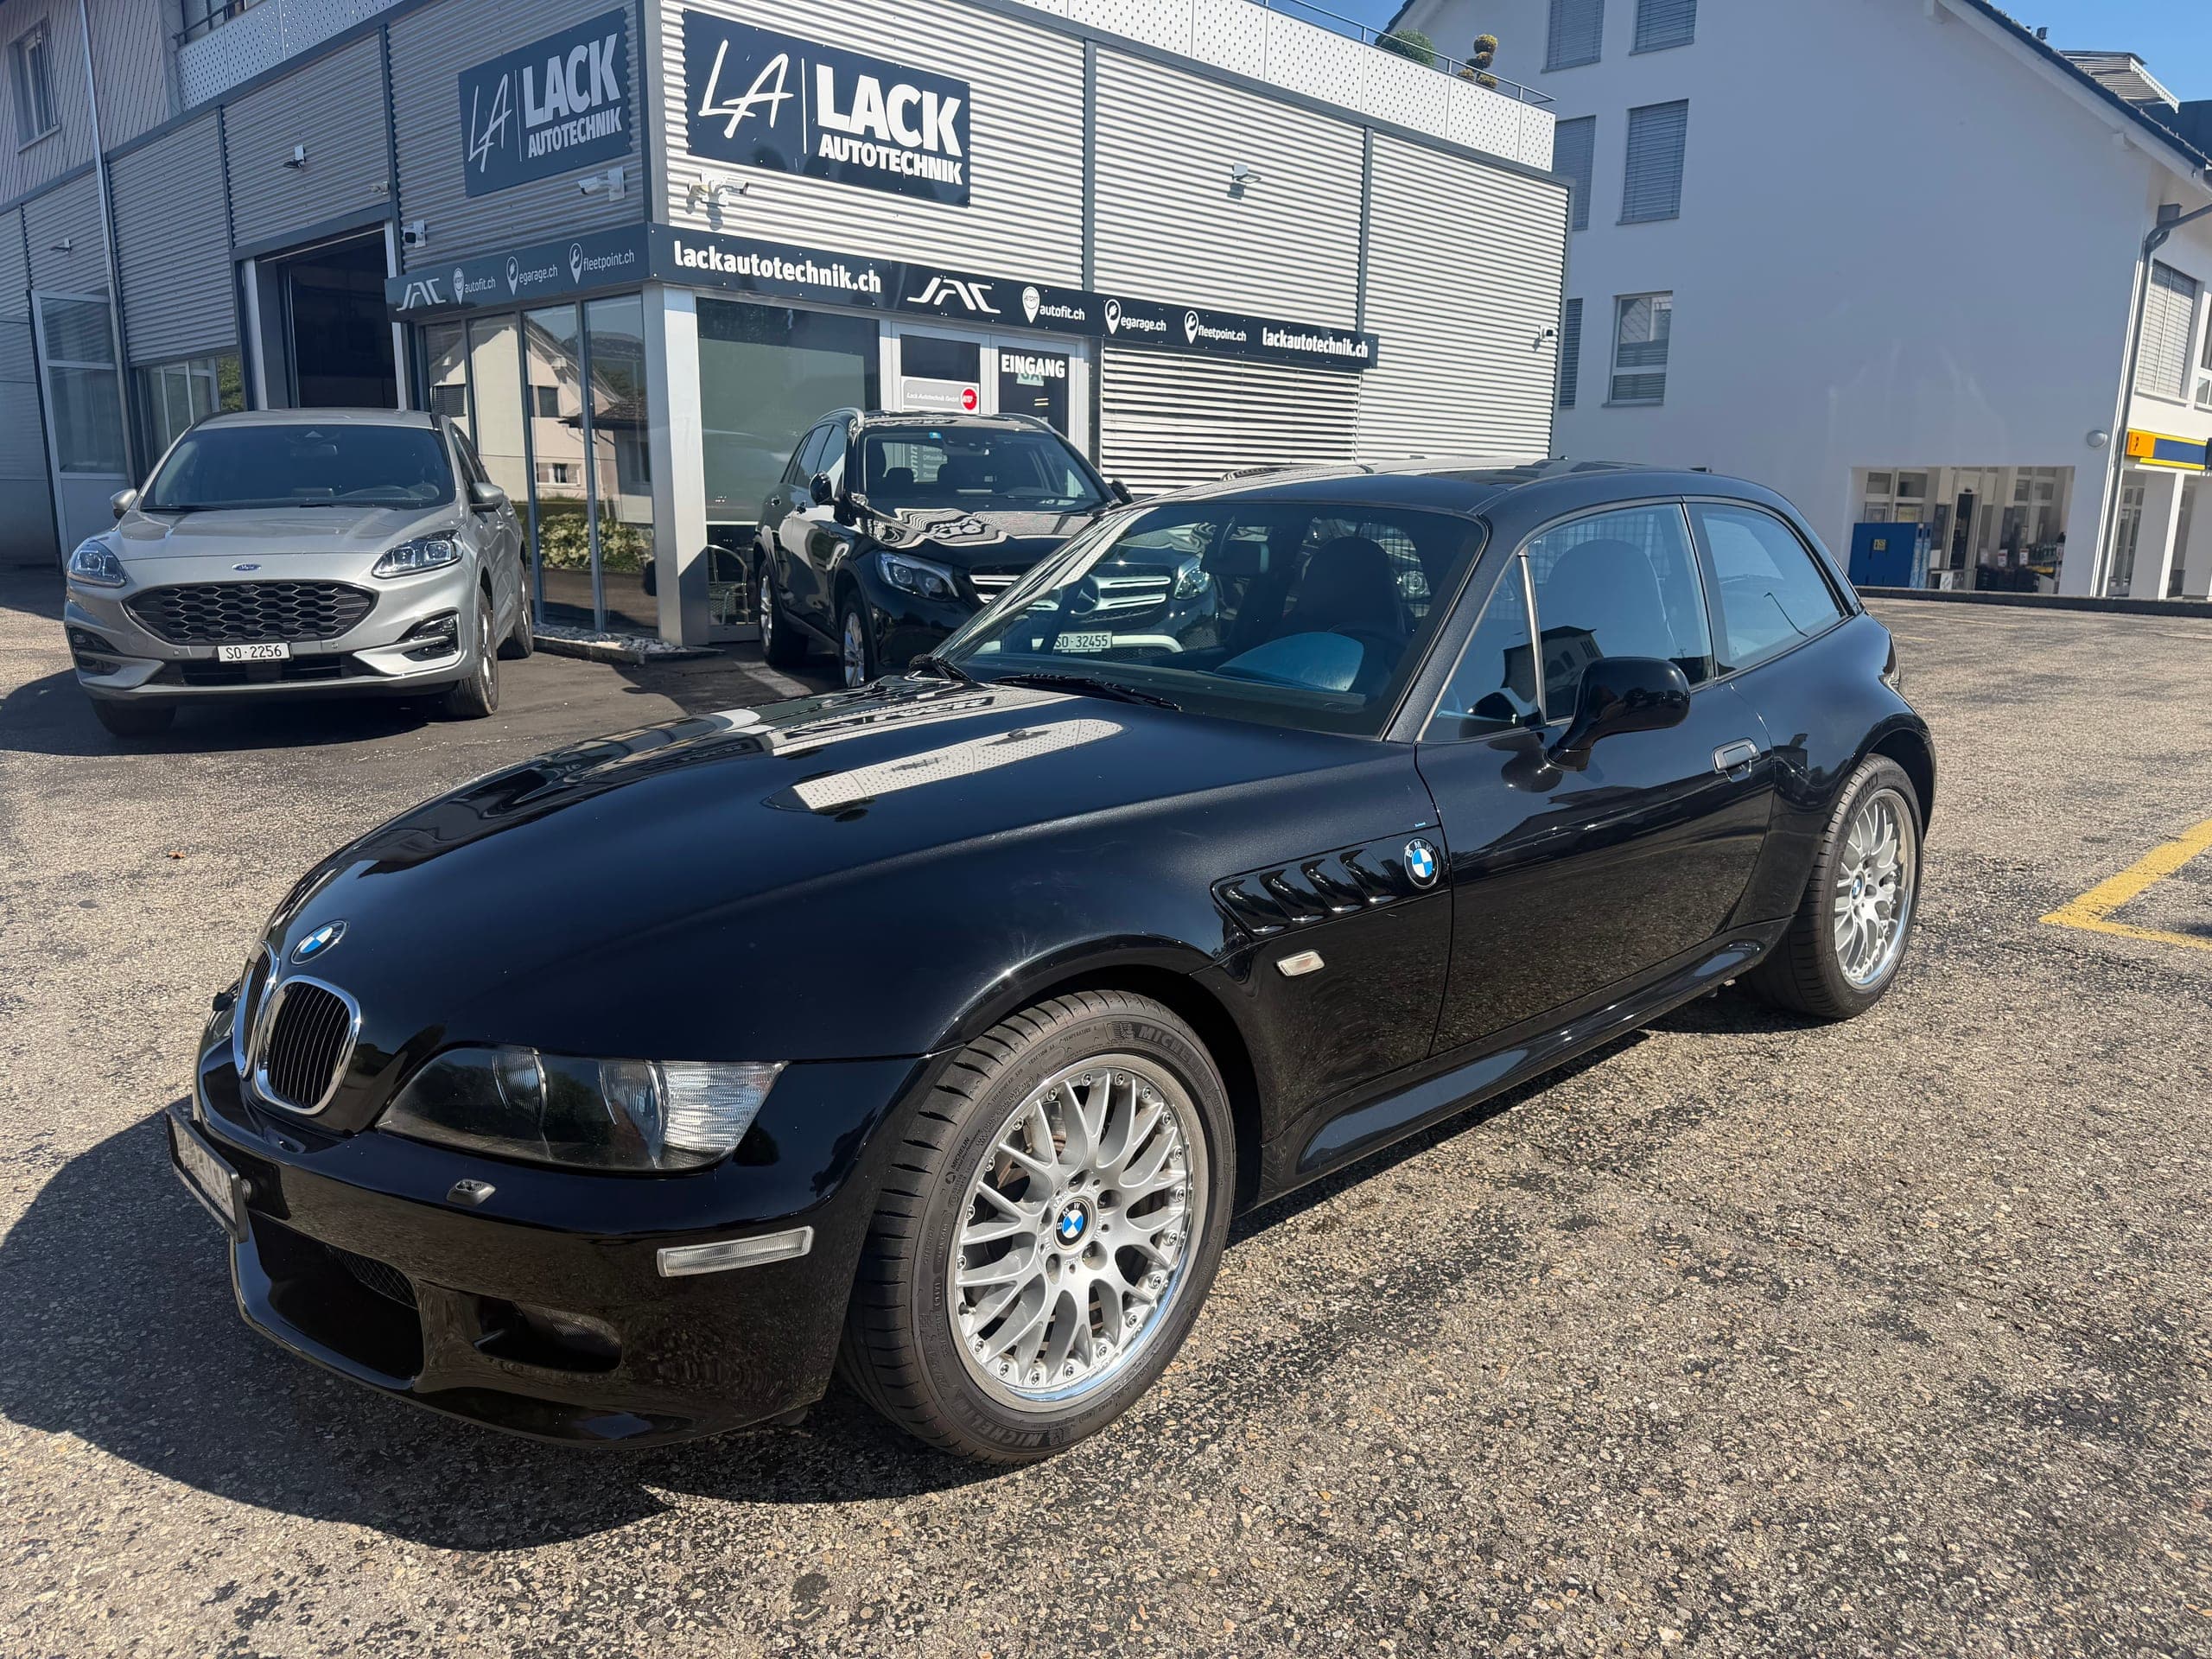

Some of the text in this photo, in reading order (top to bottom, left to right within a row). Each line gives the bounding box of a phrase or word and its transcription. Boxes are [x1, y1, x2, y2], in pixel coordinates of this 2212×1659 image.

[523, 33, 620, 129] LACK
[698, 39, 795, 139] LA
[816, 63, 963, 158] LACK
[527, 108, 623, 159] AUTOTECHNIK
[817, 134, 963, 186] AUTOTECHNIK
[518, 264, 558, 285] egarage.ch
[583, 250, 635, 271] fleetpoint.ch
[674, 240, 881, 294] lackautotechnik.ch
[464, 277, 496, 294] autofit.ch
[1039, 302, 1085, 321] autofit.ch
[1121, 315, 1166, 333] egarage.ch
[1198, 324, 1247, 342] fleetpoint.ch
[1262, 327, 1369, 359] lackautotechnik.ch
[1001, 353, 1065, 378] EINGANG
[1406, 841, 1433, 858] BMW
[950, 1136, 970, 1170] MICHELIN
[1056, 1202, 1081, 1230] BMW
